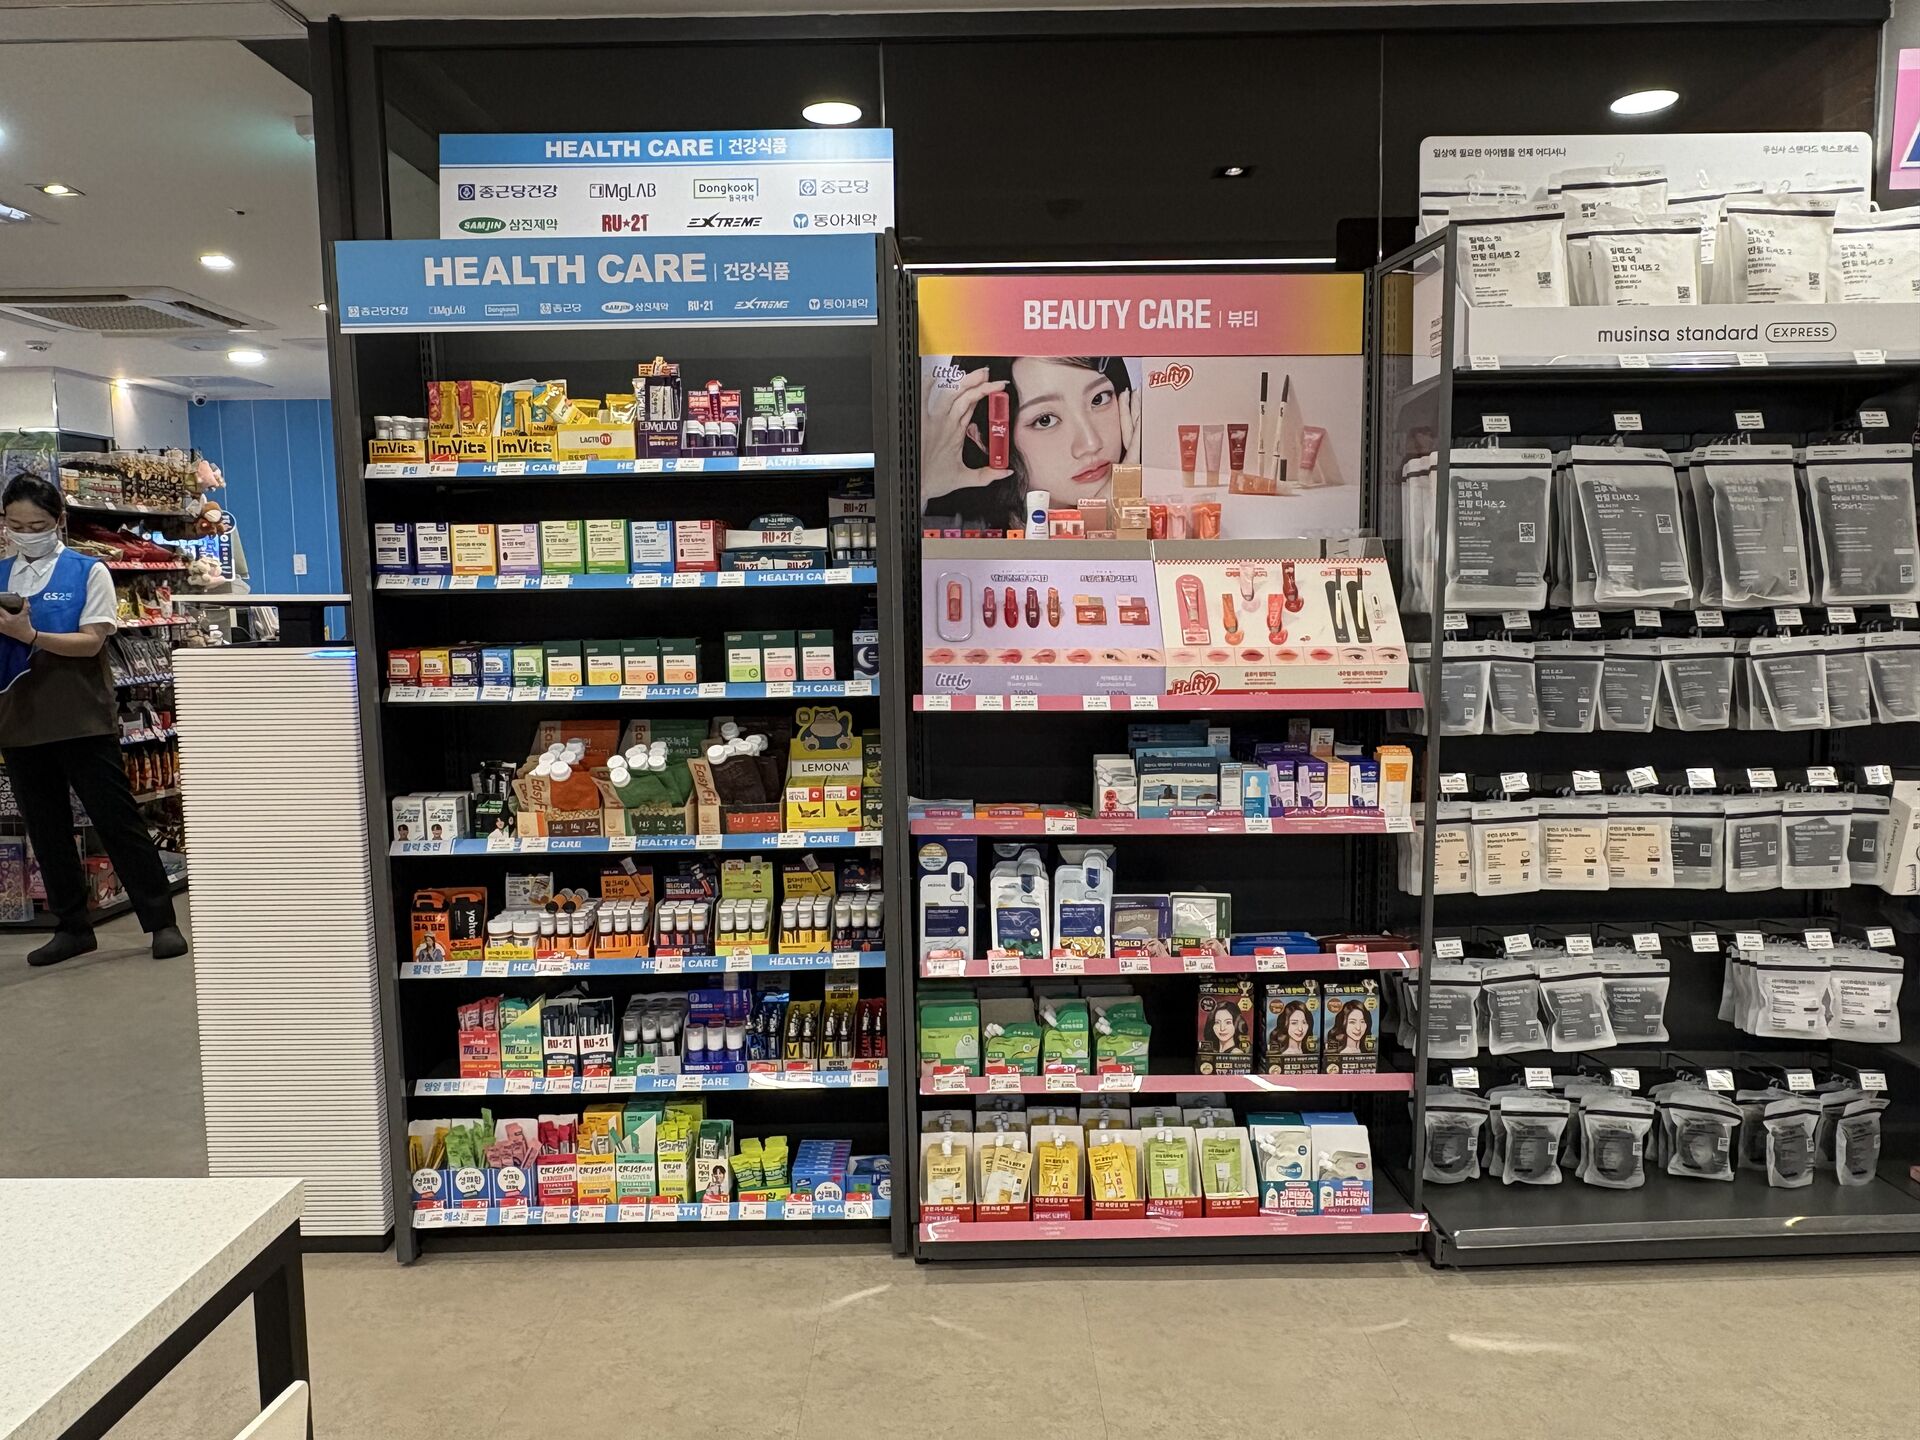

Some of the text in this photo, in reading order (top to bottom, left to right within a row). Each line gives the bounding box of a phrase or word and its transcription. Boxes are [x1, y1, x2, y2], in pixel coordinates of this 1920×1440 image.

[545, 138, 713, 159] HEALTH CARE
[727, 138, 787, 156] 건강식품
[1459, 148, 1482, 157] 필요한
[1484, 148, 1515, 158] 아이템을
[1518, 148, 1533, 157] 언제
[1535, 147, 1567, 157] 어디서나
[479, 183, 558, 200] 종근당건강
[698, 181, 755, 196] Dongkook
[821, 178, 870, 195] 종근당
[508, 217, 558, 232] 삼진제약
[686, 212, 763, 230] EXTREME
[813, 212, 878, 228] 동아제약
[1514, 250, 1521, 258] 2
[424, 252, 707, 287] HEALTH CARE
[723, 261, 790, 282] 건강식품
[1654, 263, 1660, 271] 2
[552, 303, 582, 313] 종근당
[634, 301, 669, 312] 삼진제약
[823, 298, 869, 309] 동아제약
[1023, 298, 1212, 330] BEAUTY CARE
[1226, 310, 1259, 328] 뷰티
[1598, 324, 1759, 343] musinsa standard
[1773, 327, 1830, 338] EXPRESS
[531, 464, 561, 472] CAR
[766, 458, 798, 468] ALTH
[1634, 493, 1640, 501] 2
[1500, 500, 1507, 508] 2
[758, 572, 827, 582] HEALTH CA
[43, 592, 73, 601] GS25
[813, 684, 845, 692] CARE
[801, 762, 849, 773] LEMONA
[636, 838, 681, 847] HEALTH
[809, 835, 840, 843] CARE
[551, 841, 582, 849] CARE
[568, 961, 591, 970] ARE
[688, 959, 719, 968] CARE
[768, 957, 813, 966] HEALTH
[516, 1197, 528, 1206] 2+1
